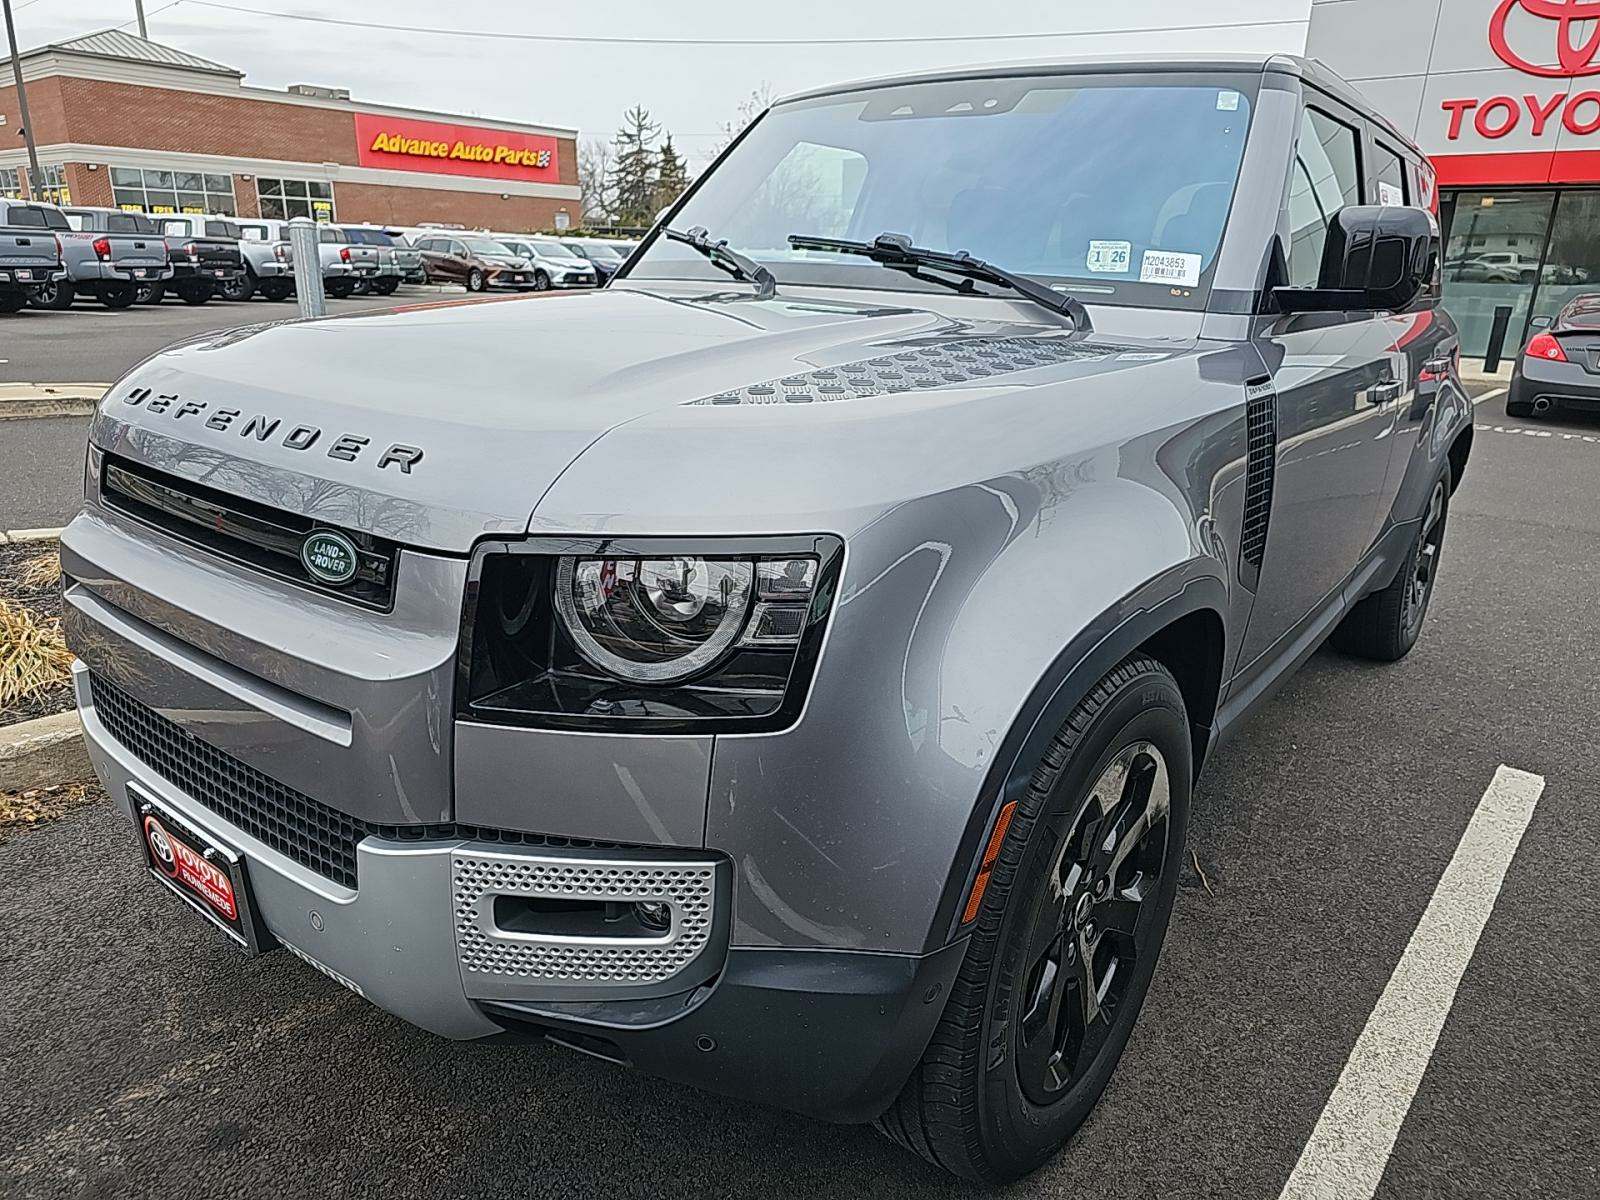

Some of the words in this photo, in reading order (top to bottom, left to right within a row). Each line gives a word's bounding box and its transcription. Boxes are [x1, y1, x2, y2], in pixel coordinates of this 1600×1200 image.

[1441, 90, 1600, 140] TOYO
[371, 132, 449, 158] Advance
[450, 141, 493, 162] Auto
[494, 145, 538, 166] Parts
[1094, 251, 1101, 262] 1
[1111, 250, 1126, 263] 26
[1144, 255, 1185, 269] M2043853
[123, 388, 424, 474] DEFENDER
[314, 541, 339, 558] LAND
[314, 554, 346, 573] ROVER
[172, 839, 231, 895] TOYOTA
